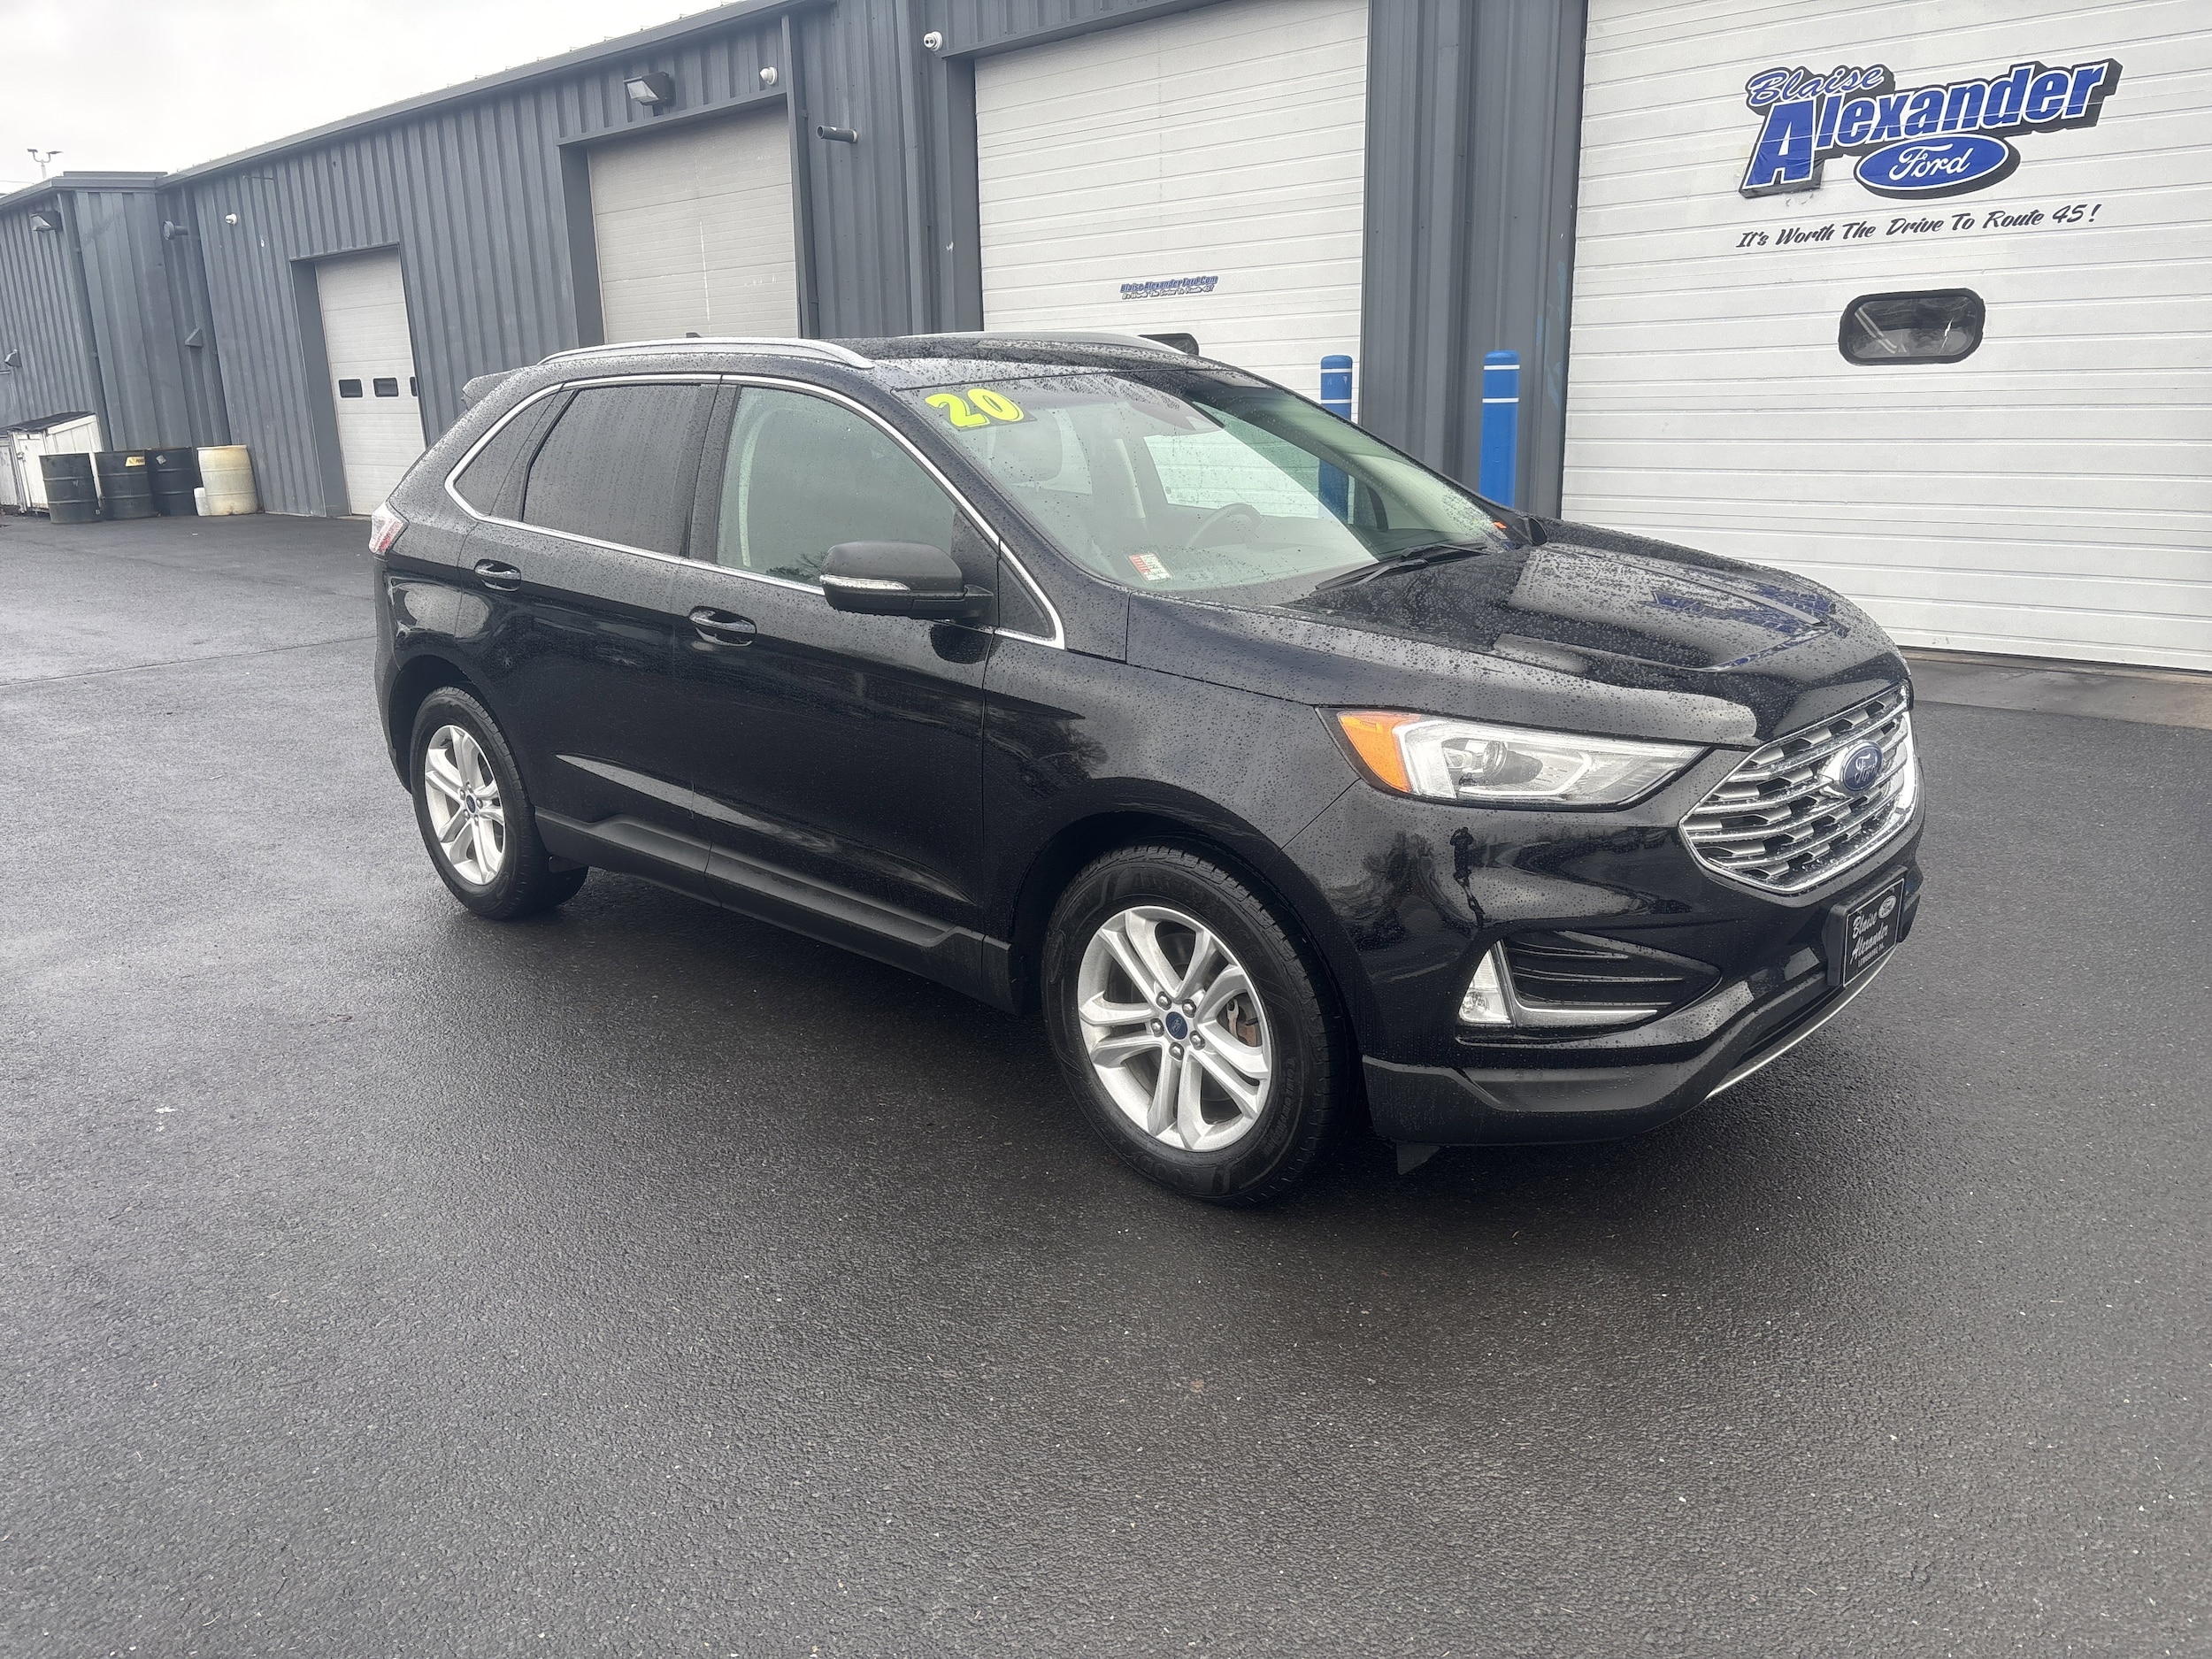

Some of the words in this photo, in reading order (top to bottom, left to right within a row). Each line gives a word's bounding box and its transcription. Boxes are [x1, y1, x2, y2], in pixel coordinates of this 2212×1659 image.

[1748, 66, 1885, 106] Blaise
[1742, 62, 2109, 190] Alexander
[1888, 142, 1971, 180] Ford
[1735, 231, 1770, 249] It's
[1775, 223, 1835, 246] Worth
[1842, 221, 1877, 240] The
[1886, 217, 1945, 236] Drive
[1951, 212, 1976, 231] To
[1981, 209, 2046, 229] Route
[925, 388, 1025, 427] 20
[1855, 752, 1878, 784] Ford
[1849, 922, 1889, 965] Alexander
[1852, 911, 1878, 940] Blaise
